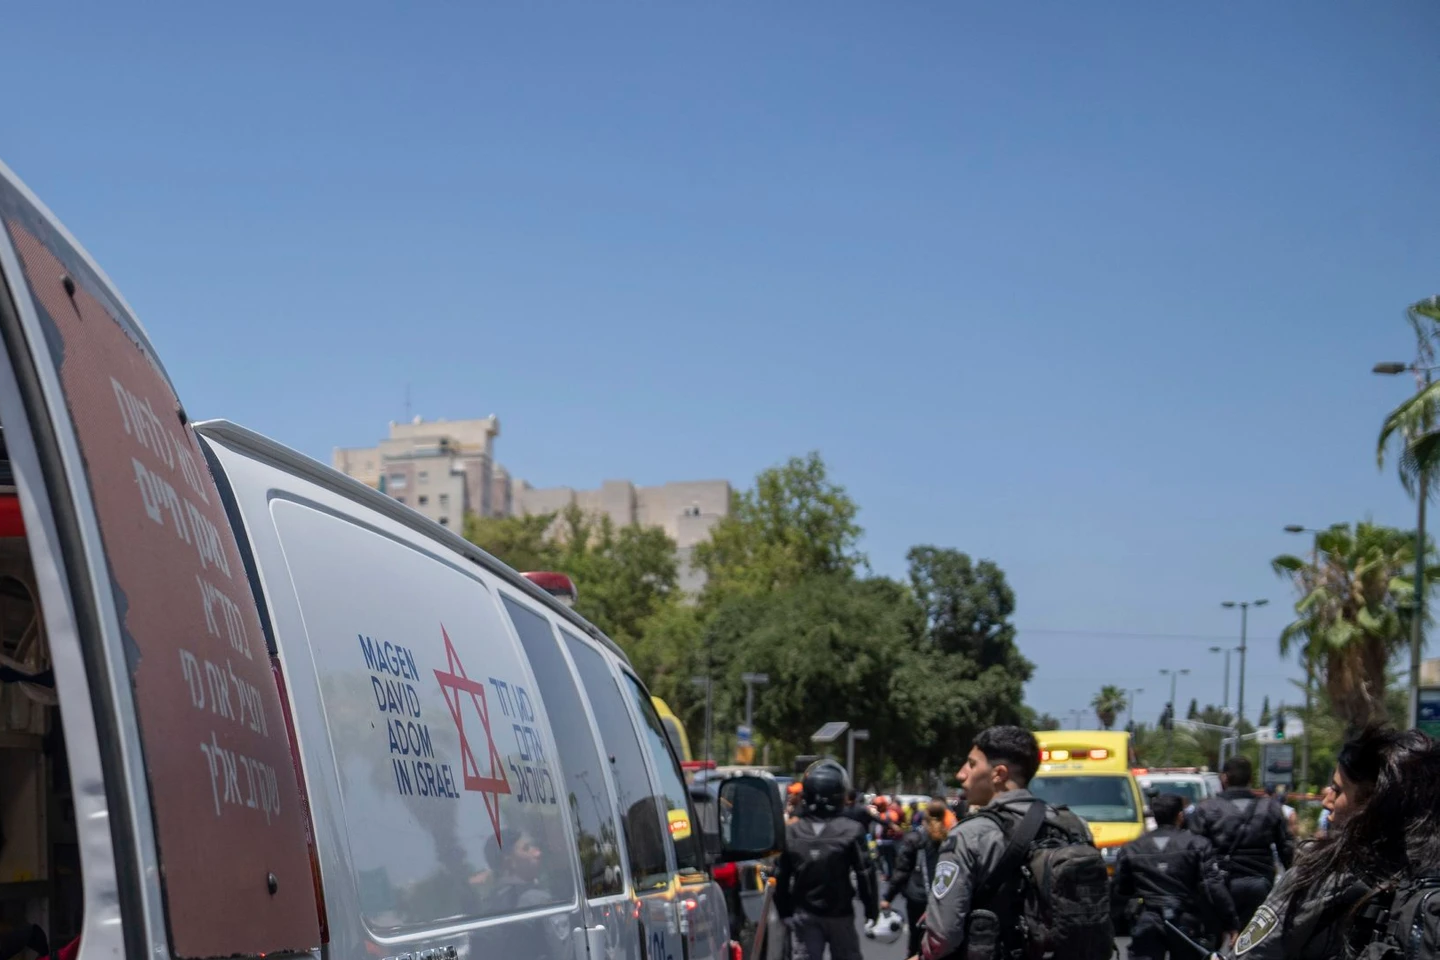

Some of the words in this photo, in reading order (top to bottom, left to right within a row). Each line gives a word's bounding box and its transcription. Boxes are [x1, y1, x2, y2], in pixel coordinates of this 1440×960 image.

[110, 376, 175, 470] להיות
[131, 457, 192, 545] חיים
[179, 648, 205, 709] מי
[358, 634, 420, 682] MAGEN
[205, 659, 236, 721] את
[371, 675, 421, 719] DAVID
[488, 677, 516, 719] דוד
[387, 719, 435, 759] ADOM
[512, 723, 547, 764] אדום
[200, 731, 243, 816] אליך
[240, 754, 281, 826] שקרוב
[392, 758, 413, 796] IN
[412, 761, 460, 799] ISRAEL
[507, 754, 557, 804] בישראל
